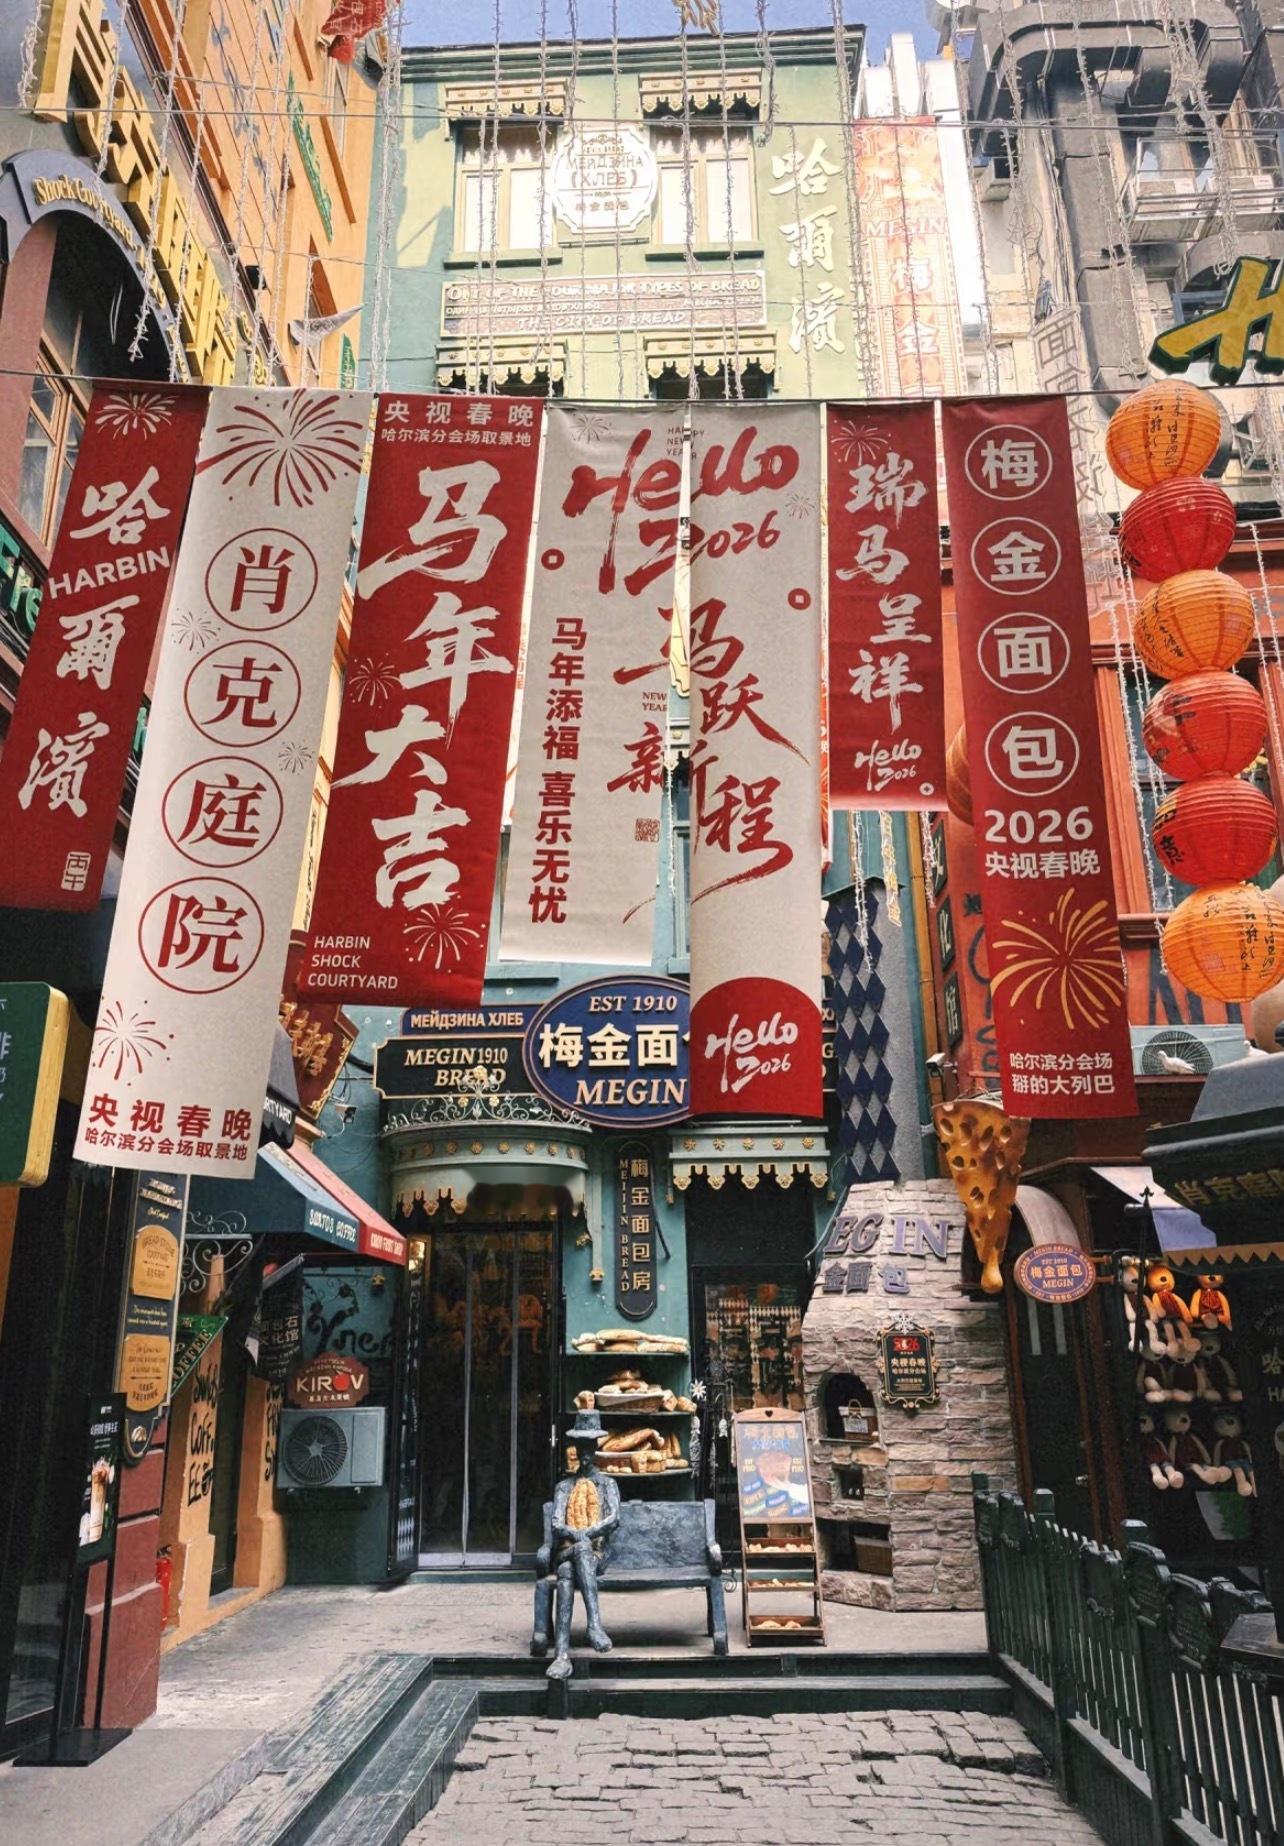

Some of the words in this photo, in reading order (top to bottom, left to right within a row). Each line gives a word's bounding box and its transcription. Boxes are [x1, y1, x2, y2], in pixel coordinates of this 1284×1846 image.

[33, 173, 77, 206] Shock
[640, 280, 684, 294] TYPES
[556, 314, 597, 329] CITY
[384, 401, 535, 428] 央视春晚
[381, 427, 533, 447] 哈尔滨分会场取景地
[562, 425, 799, 595] Hello
[49, 546, 171, 600] HARBIN
[836, 452, 932, 735] 瑞马呈祥
[980, 438, 1064, 779] 梅金面包
[18, 464, 172, 819] 哈爾濱
[331, 460, 514, 909] 马年大吉
[543, 616, 587, 762] 马年添福
[156, 544, 297, 973] 肖克庭院
[854, 738, 922, 792] Hello
[984, 805, 1094, 844] 2026
[528, 770, 577, 925] 喜乐无忧
[985, 848, 1101, 880] 央视春晚
[64, 853, 90, 890] 丙午
[311, 953, 361, 969] SHOCK
[314, 935, 371, 951] HARBIN
[308, 972, 399, 989] COURTYARD
[410, 1010, 486, 1030] МЕЙДЗИНА
[487, 1011, 525, 1027] ХЛЕБ
[588, 995, 627, 1012] EST
[632, 995, 678, 1012] 1910
[404, 1048, 477, 1067] MEGIN
[477, 1047, 509, 1065] 1910
[538, 1022, 690, 1068] 梅金面
[704, 1011, 799, 1093] Hello
[1009, 1051, 1114, 1072] 哈尔滨分会场
[574, 1078, 688, 1106] MEGIN
[730, 1053, 792, 1094] 2026
[1011, 1074, 1116, 1096] 掰的大列巴
[88, 1093, 254, 1141] 央视春晚
[84, 1126, 249, 1162] 哈尔滨分会场取景地
[631, 1158, 651, 1292] 梅金面包房
[620, 1234, 630, 1292] BREAD
[172, 1327, 213, 1389] OFFEE
